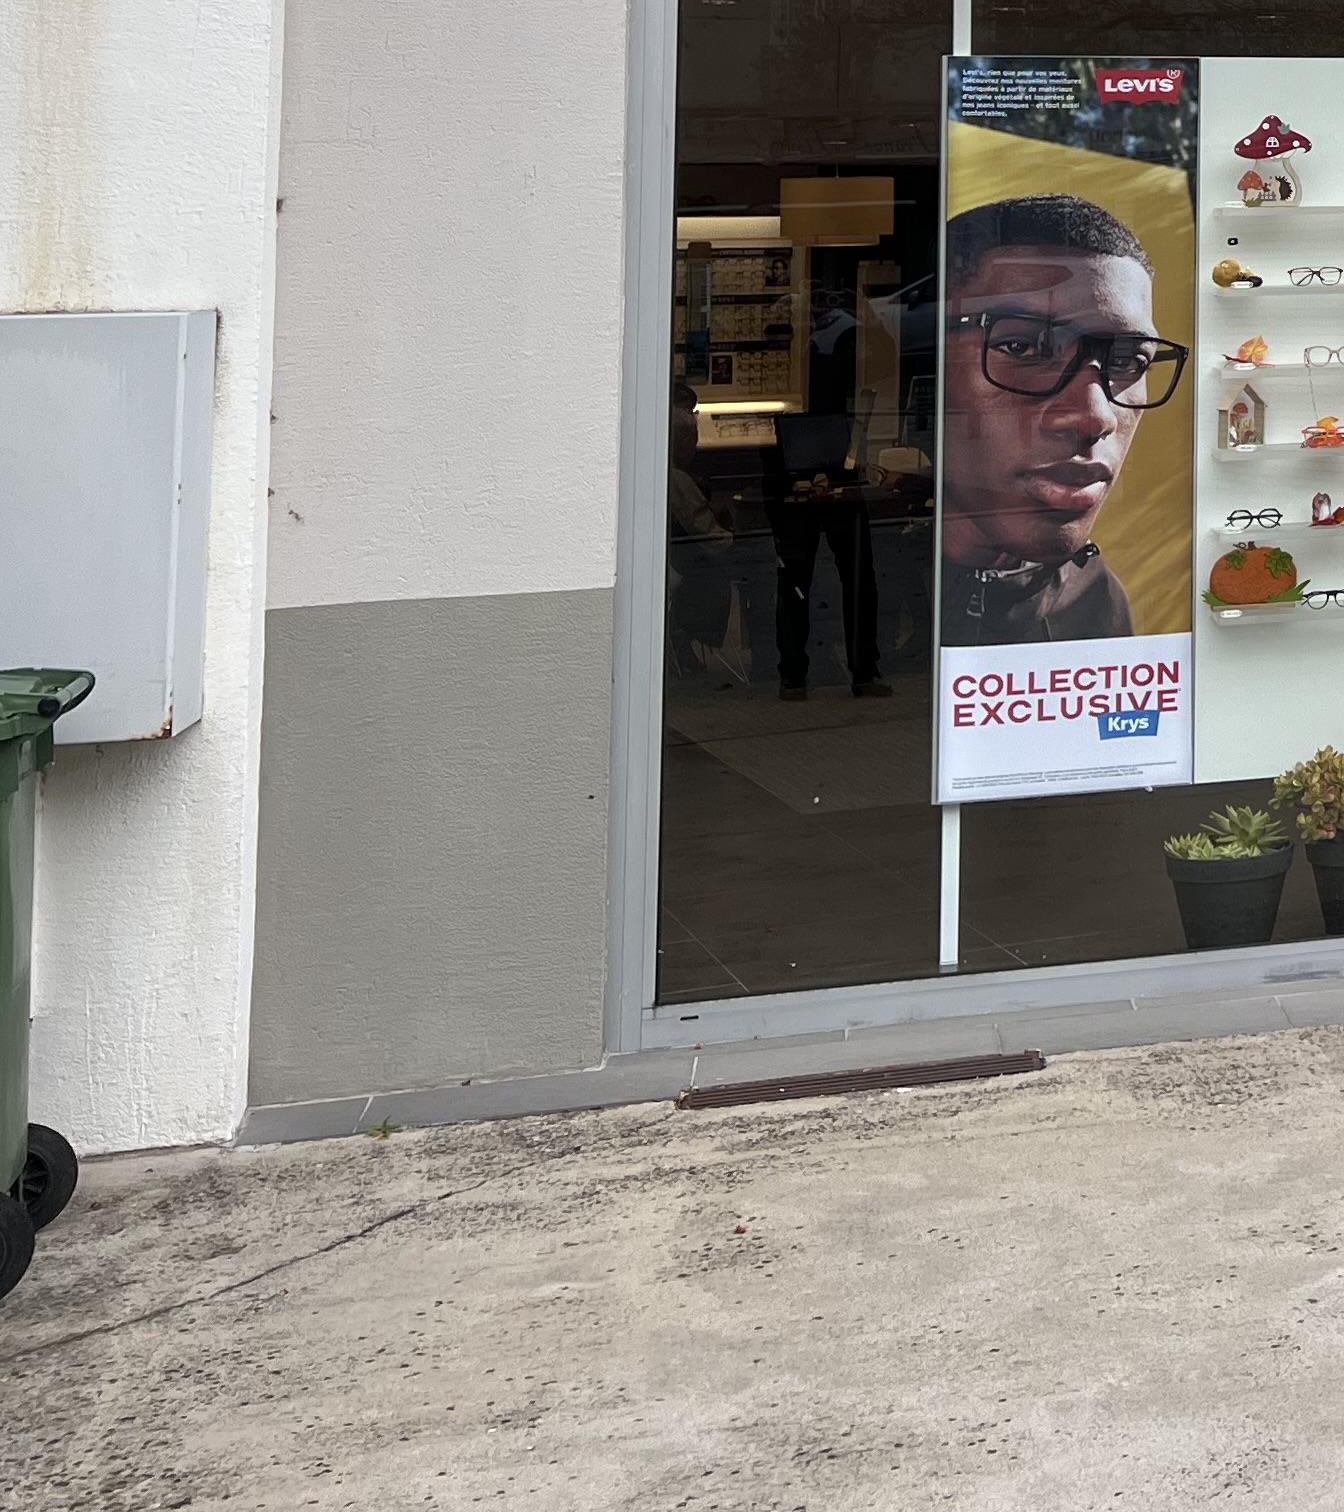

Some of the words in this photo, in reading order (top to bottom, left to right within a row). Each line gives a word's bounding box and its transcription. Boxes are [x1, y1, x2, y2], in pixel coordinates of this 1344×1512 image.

[953, 661, 1179, 698] COLLECTION
[953, 689, 1179, 728] EXCLUSIVE
[1107, 714, 1150, 733] Krys
